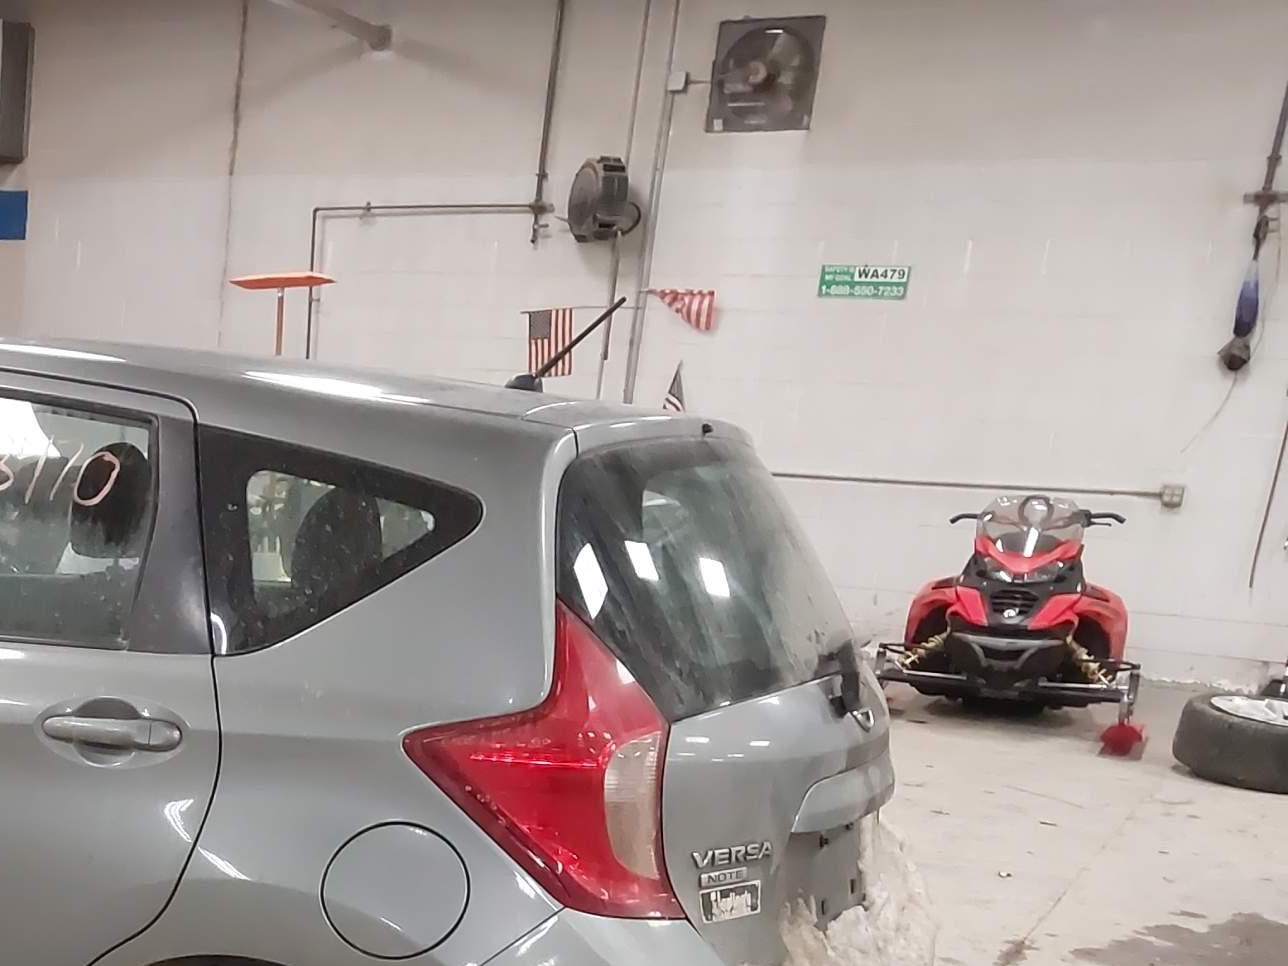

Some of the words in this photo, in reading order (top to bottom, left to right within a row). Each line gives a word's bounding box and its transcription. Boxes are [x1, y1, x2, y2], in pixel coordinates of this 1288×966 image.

[858, 268, 906, 279] WA479
[692, 841, 772, 868] VERSA
[708, 870, 743, 883] NOTE
